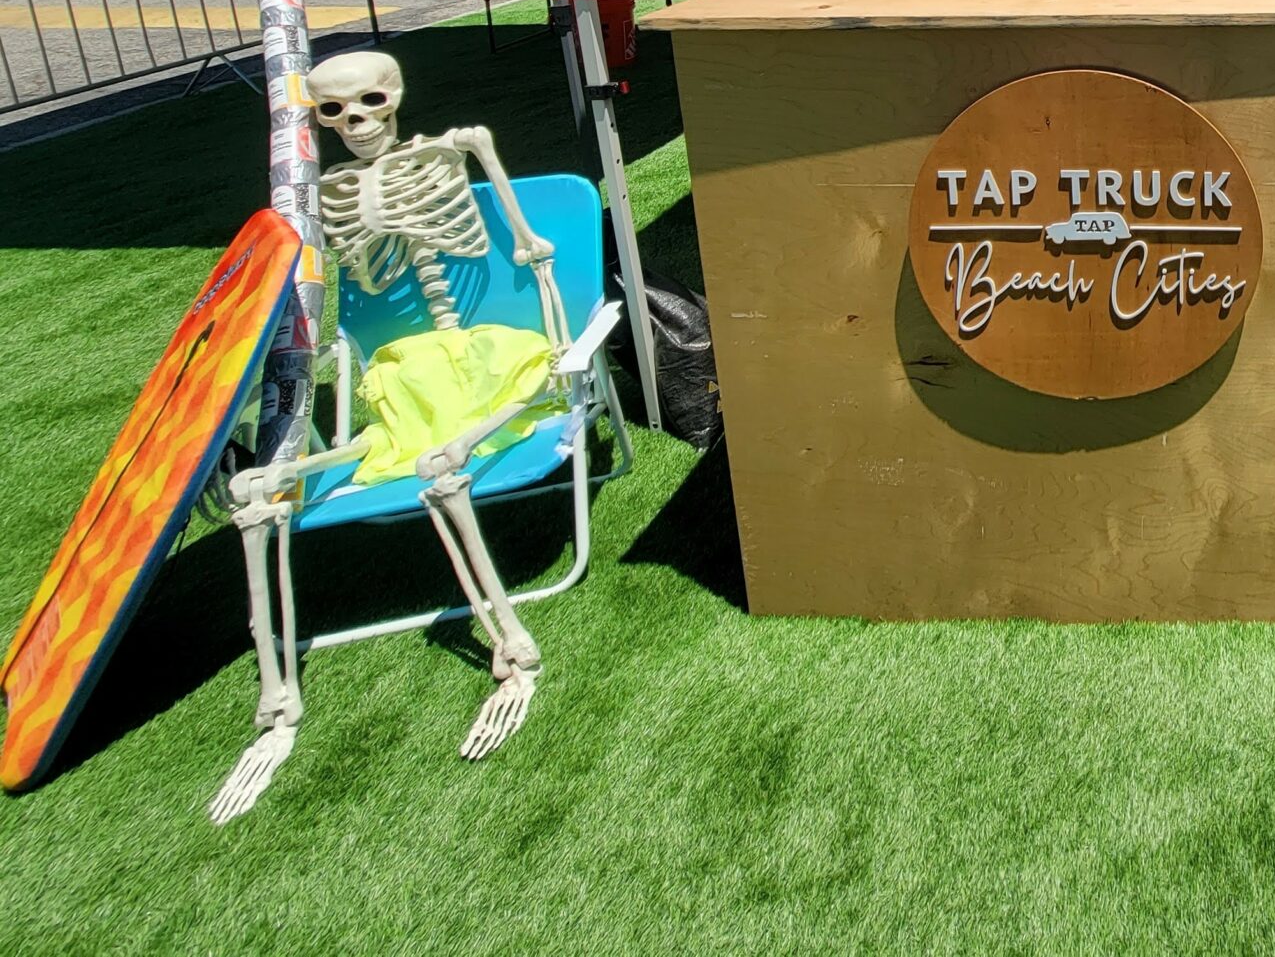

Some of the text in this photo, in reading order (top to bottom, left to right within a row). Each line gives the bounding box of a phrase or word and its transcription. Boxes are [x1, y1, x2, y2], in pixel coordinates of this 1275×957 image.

[937, 170, 1233, 207] TAP TRUCK
[1074, 219, 1116, 232] TAP
[946, 240, 1246, 332] Beach Cities
